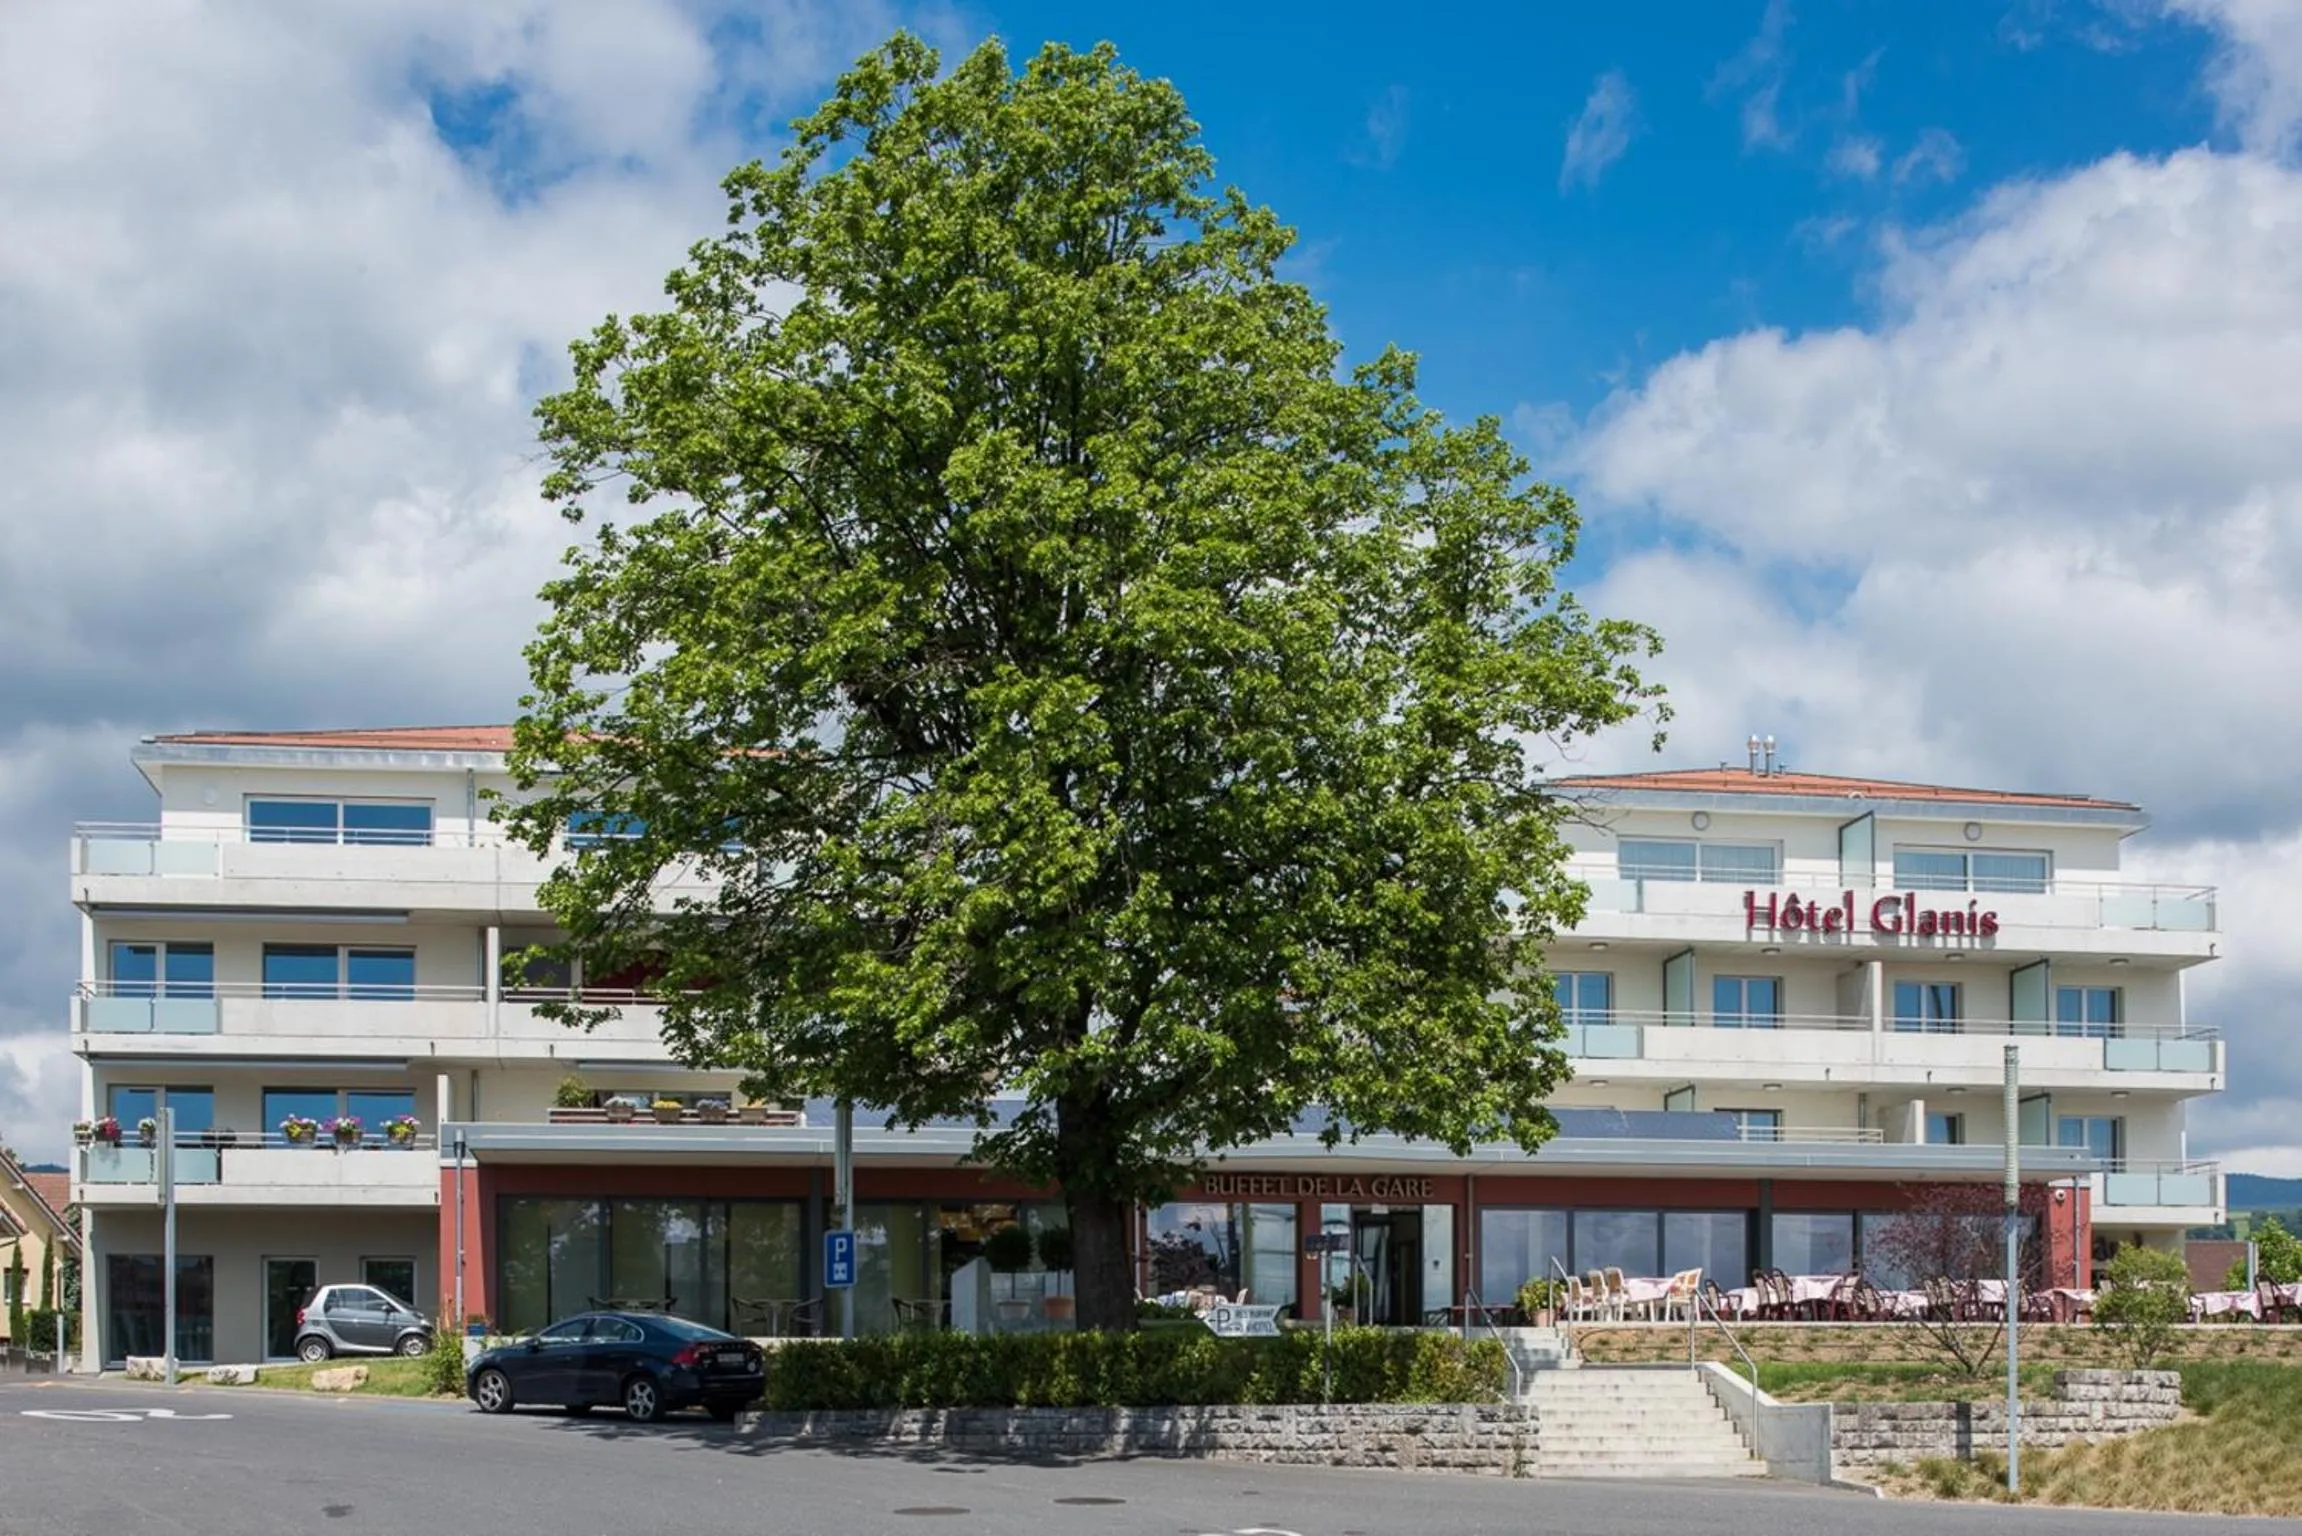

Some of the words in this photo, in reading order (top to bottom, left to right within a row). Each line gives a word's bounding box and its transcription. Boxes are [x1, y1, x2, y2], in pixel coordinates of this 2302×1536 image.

[1745, 889, 1855, 932] Hôtel
[1870, 892, 1999, 937] Glanis
[1205, 1175, 1292, 1196] BUFFET
[1298, 1176, 1329, 1197] DE
[1336, 1177, 1365, 1197] LA
[1371, 1177, 1434, 1198] GARE
[835, 1237, 848, 1261] P
[1217, 1308, 1230, 1332] P
